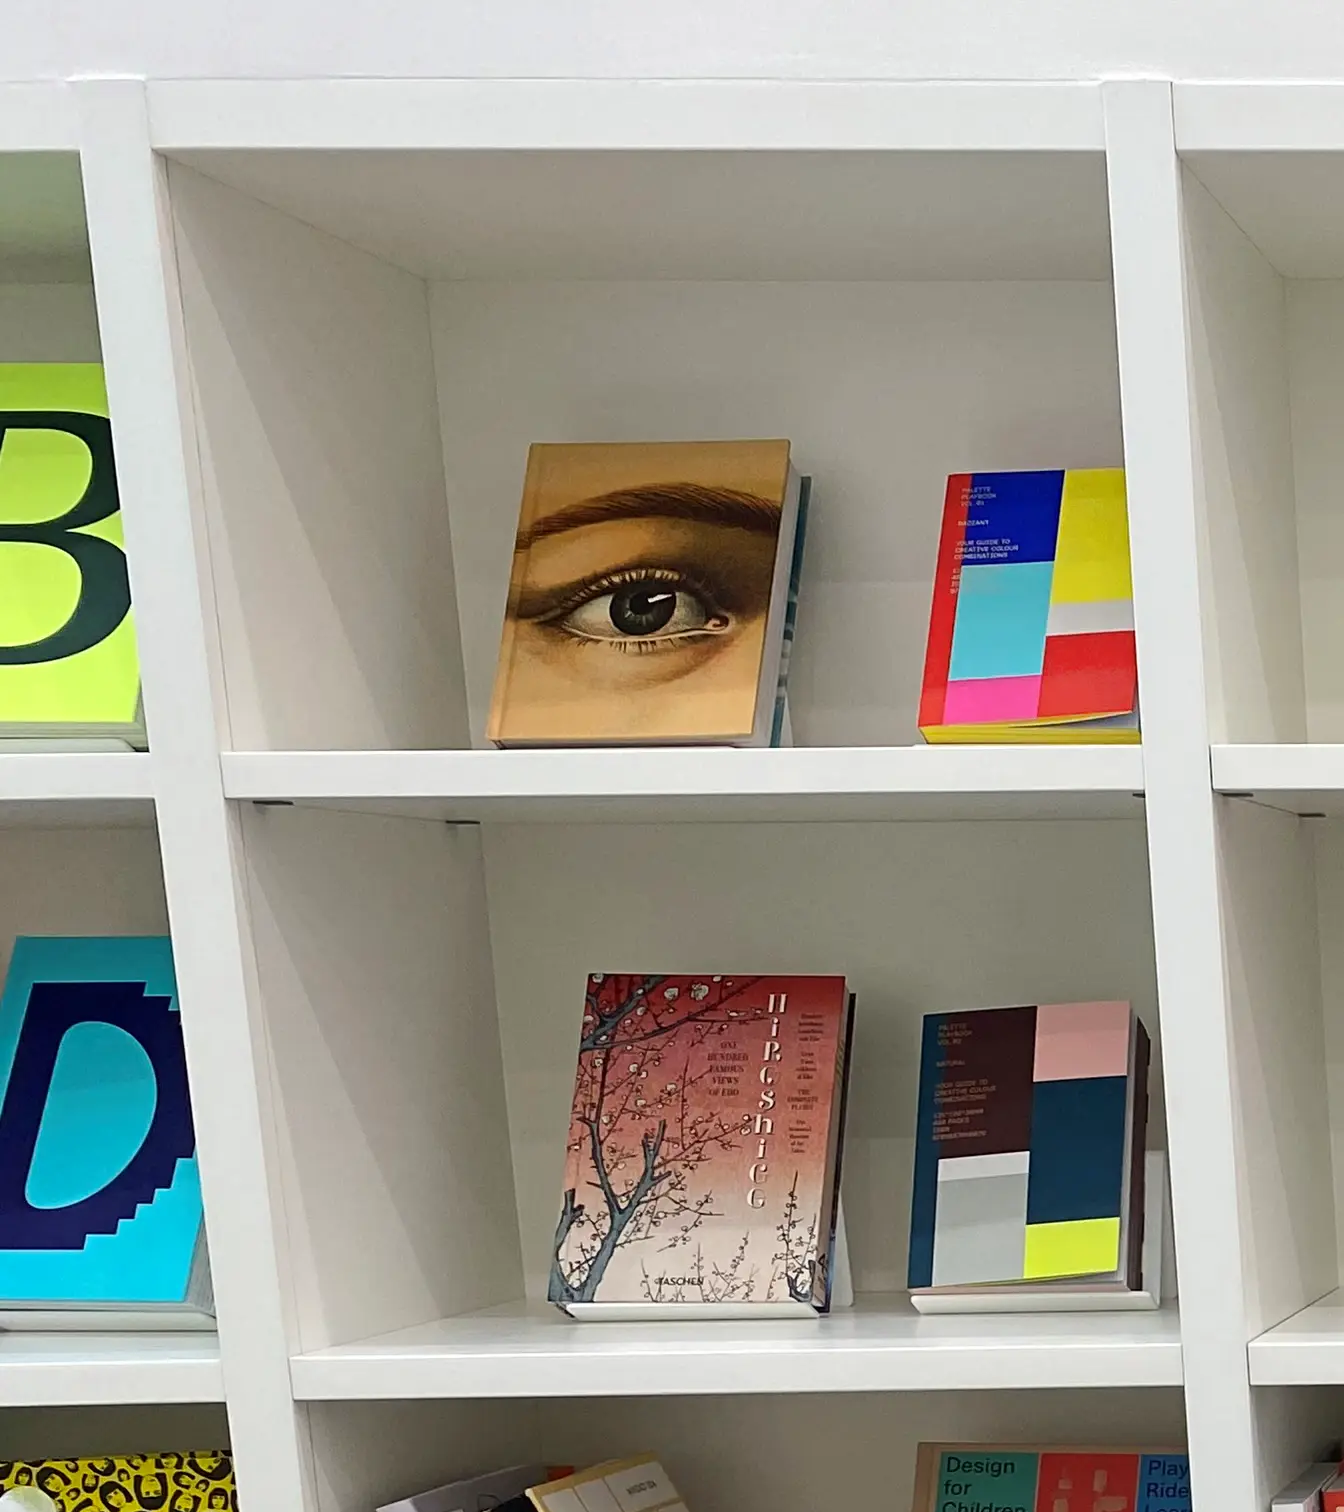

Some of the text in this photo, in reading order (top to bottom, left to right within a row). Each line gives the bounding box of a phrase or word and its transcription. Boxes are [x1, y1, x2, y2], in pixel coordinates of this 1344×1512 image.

[707, 1053, 749, 1061] HUNDRED
[710, 1065, 744, 1073] FAMOUS
[712, 1077, 739, 1085] VIEWS
[658, 1277, 704, 1286] TASCHEN
[946, 1457, 1015, 1477] Design
[1148, 1460, 1188, 1479] Play
[944, 1479, 971, 1496] for
[1146, 1482, 1188, 1499] Ride
